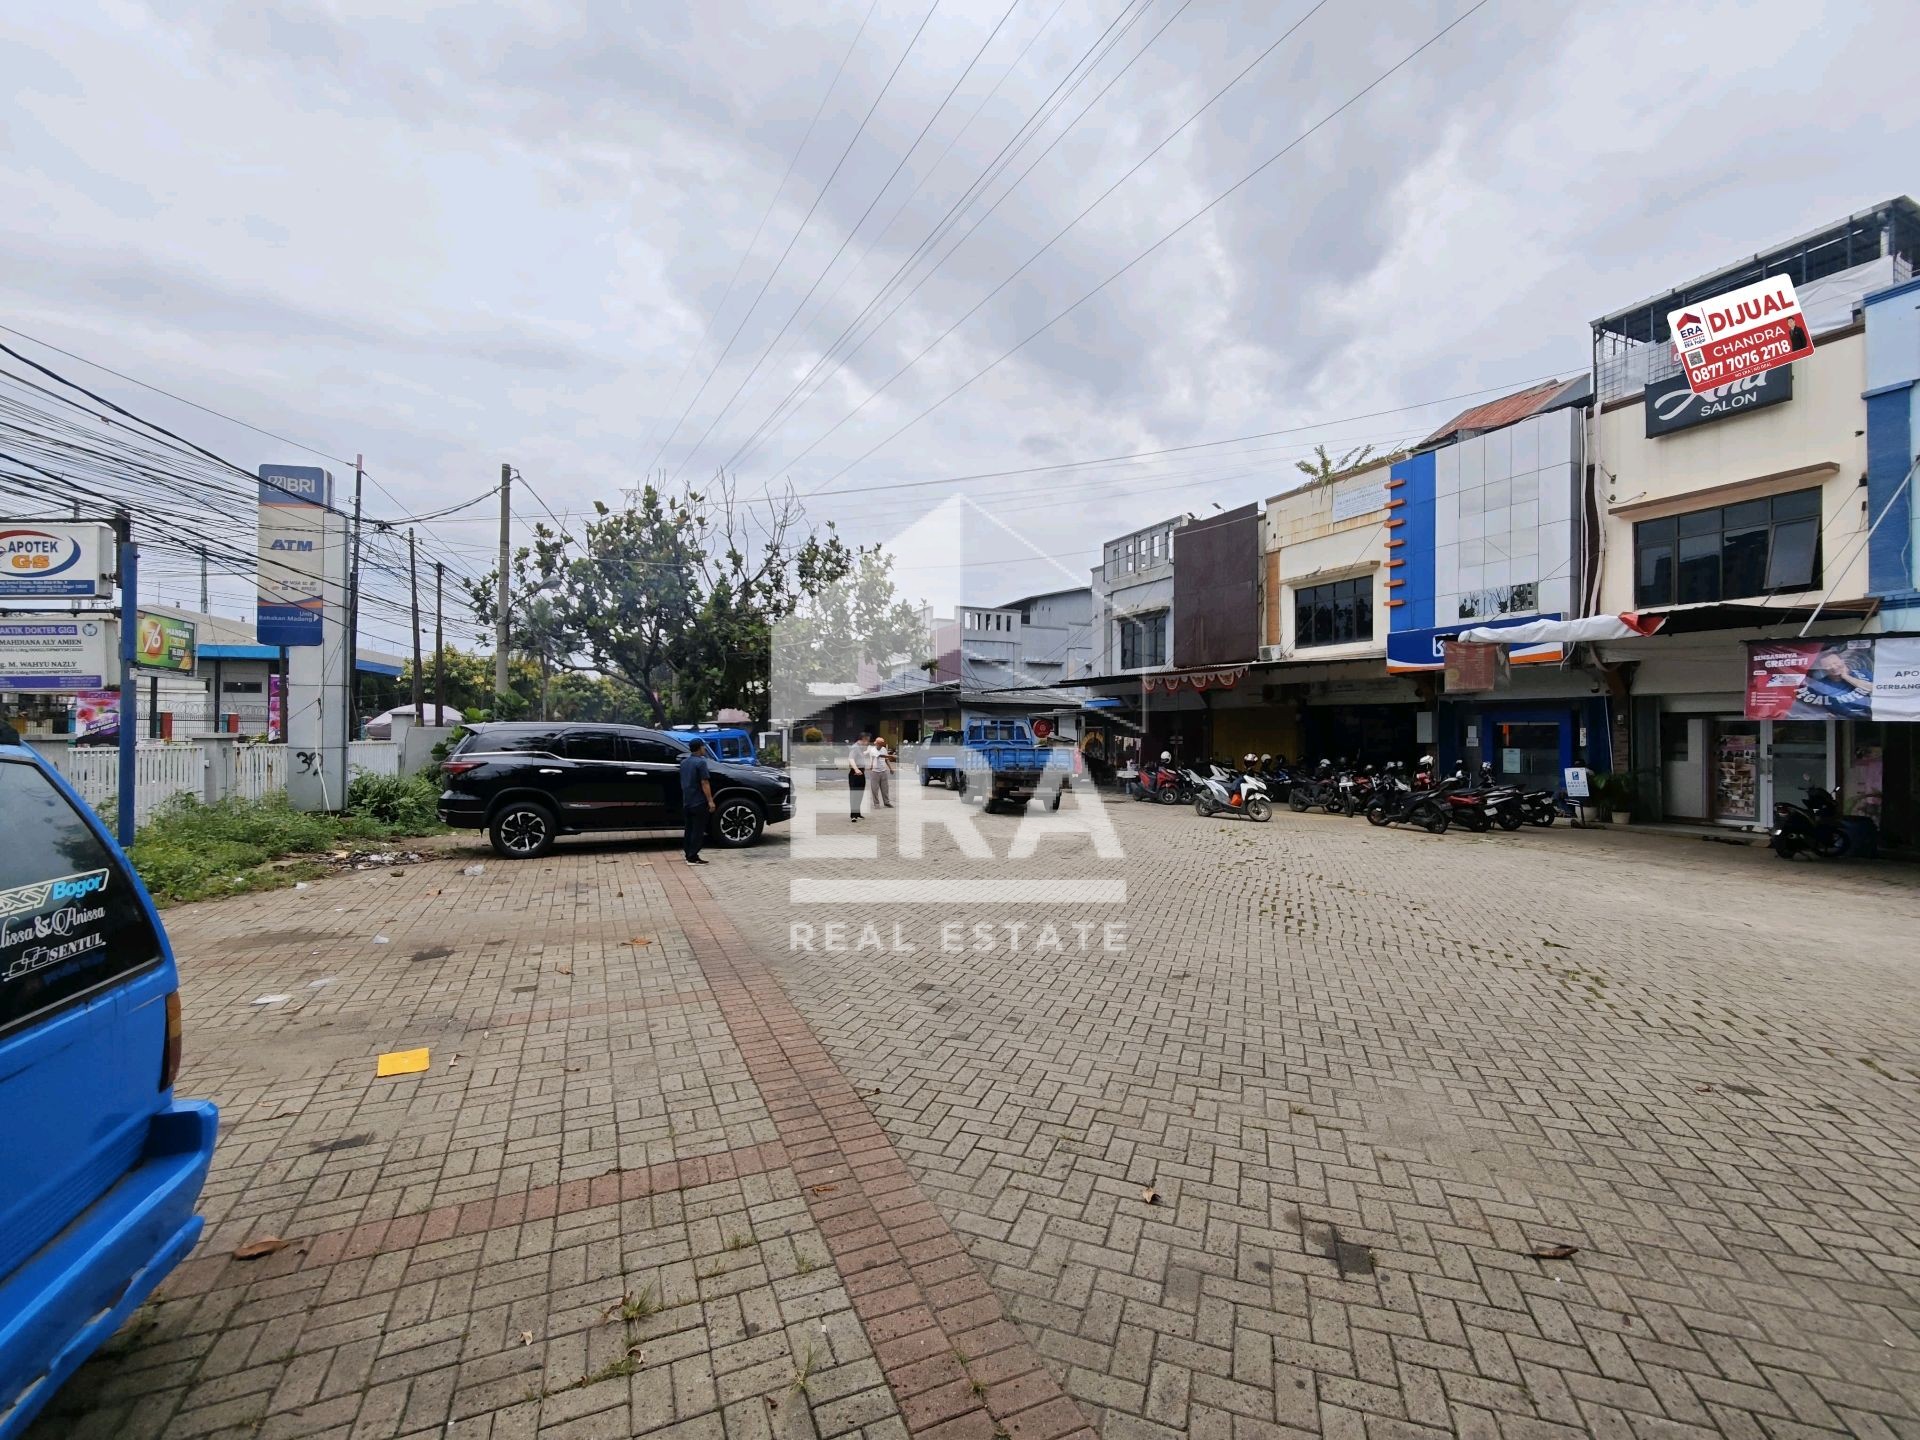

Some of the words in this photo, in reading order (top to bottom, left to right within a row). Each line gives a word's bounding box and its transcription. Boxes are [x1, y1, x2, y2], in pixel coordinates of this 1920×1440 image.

[1701, 391, 1757, 417] SALON
[287, 478, 315, 493] BRI
[8, 541, 58, 553] APOTEK
[271, 539, 312, 552] ATM
[12, 555, 50, 568] GS
[25, 626, 56, 635] DOKTER
[53, 876, 103, 900] Bogor
[51, 907, 105, 936] Anissa
[48, 933, 102, 961] SENTUL
